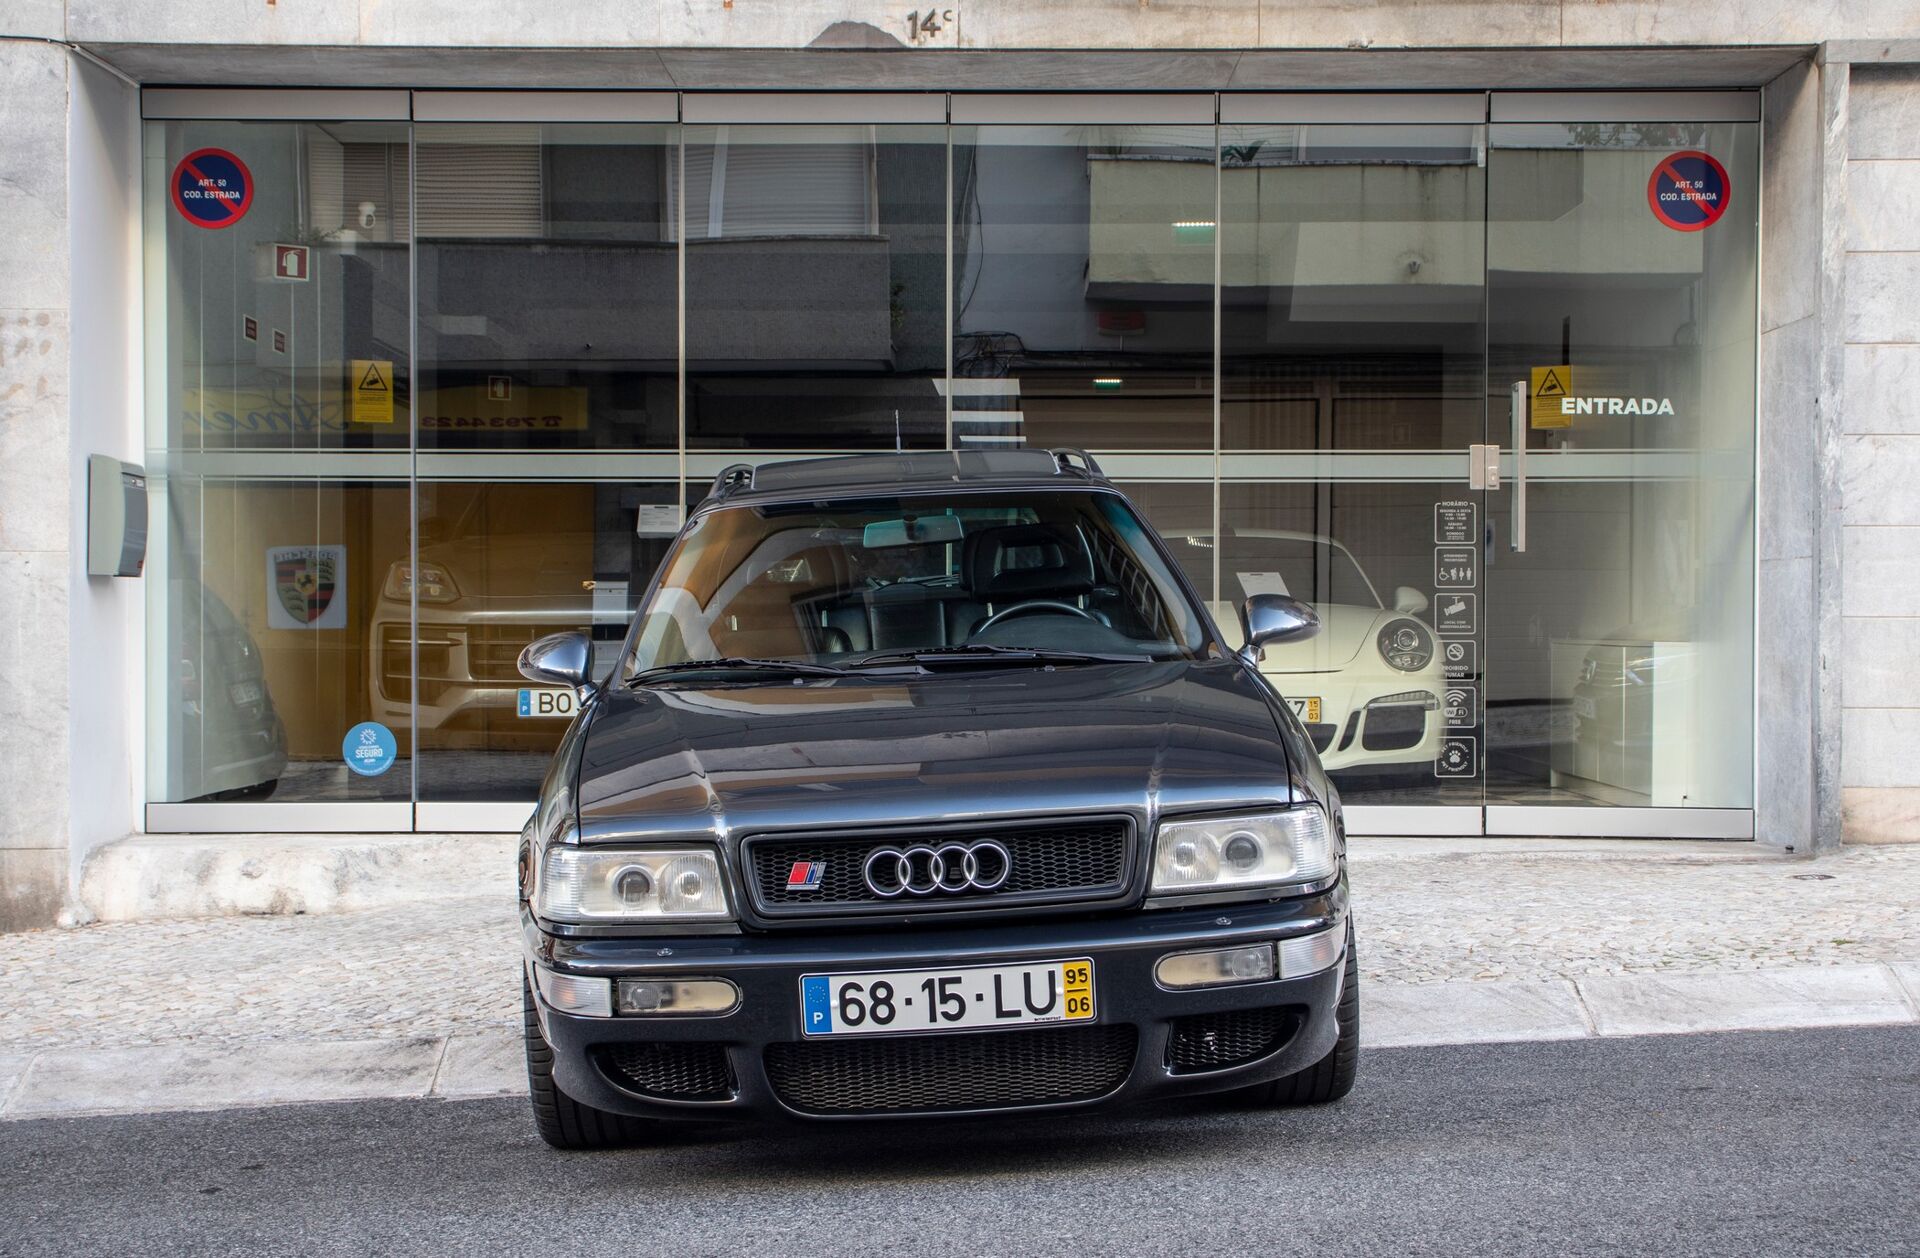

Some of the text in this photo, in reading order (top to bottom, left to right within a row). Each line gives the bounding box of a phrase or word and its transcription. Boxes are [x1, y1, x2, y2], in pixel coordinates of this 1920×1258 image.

[198, 179, 227, 187] ART. 50
[1675, 181, 1704, 189] ART. 50
[183, 190, 241, 199] COD. ESTRADA
[1660, 192, 1717, 201] COD. ESTRADA
[1561, 397, 1675, 415] ENTRADA
[355, 748, 383, 759] SEGURO
[1065, 967, 1088, 984] 95
[1066, 997, 1090, 1013] 06
[813, 1012, 824, 1024] P
